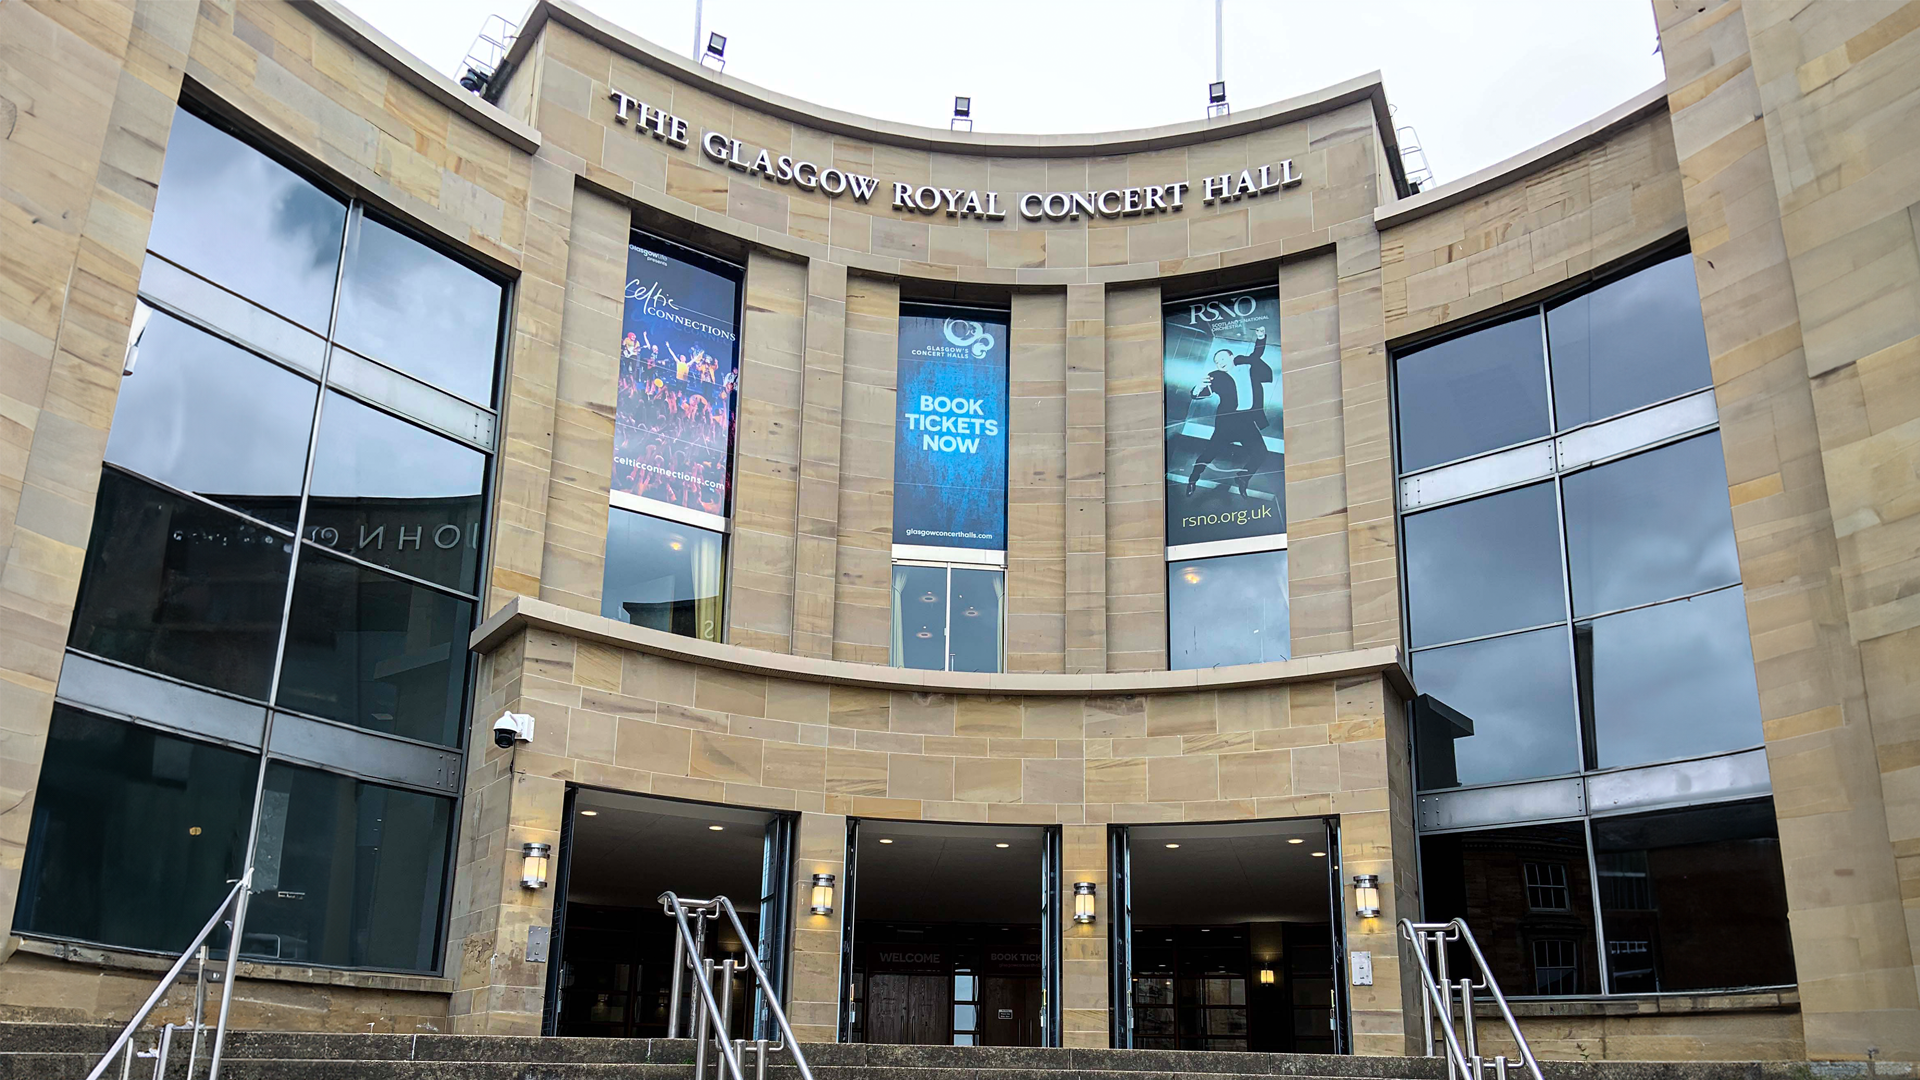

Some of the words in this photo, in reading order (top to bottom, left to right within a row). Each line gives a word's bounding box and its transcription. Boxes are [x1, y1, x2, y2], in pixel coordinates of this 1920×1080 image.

[609, 88, 690, 148] THE
[702, 131, 880, 203] GLASGOW
[892, 182, 1007, 219] ROYAL
[1019, 181, 1189, 220] CONCERT
[1202, 159, 1303, 204] HALL
[625, 279, 680, 315] Celtic
[1189, 296, 1257, 325] RSNO
[647, 307, 736, 341] CONNECTIONS
[911, 349, 945, 357] CONCERT
[926, 345, 969, 354] GLASGOW'S
[920, 395, 984, 415] BOOK
[905, 413, 999, 436] TICKETS
[922, 434, 980, 454] NOW
[613, 456, 725, 491] celticconnections.com
[1182, 504, 1272, 527] rsno.org.uk
[905, 528, 993, 539] glasgowconcerthalls.com
[879, 952, 941, 963] WELCOME
[990, 953, 1019, 961] BOOK
